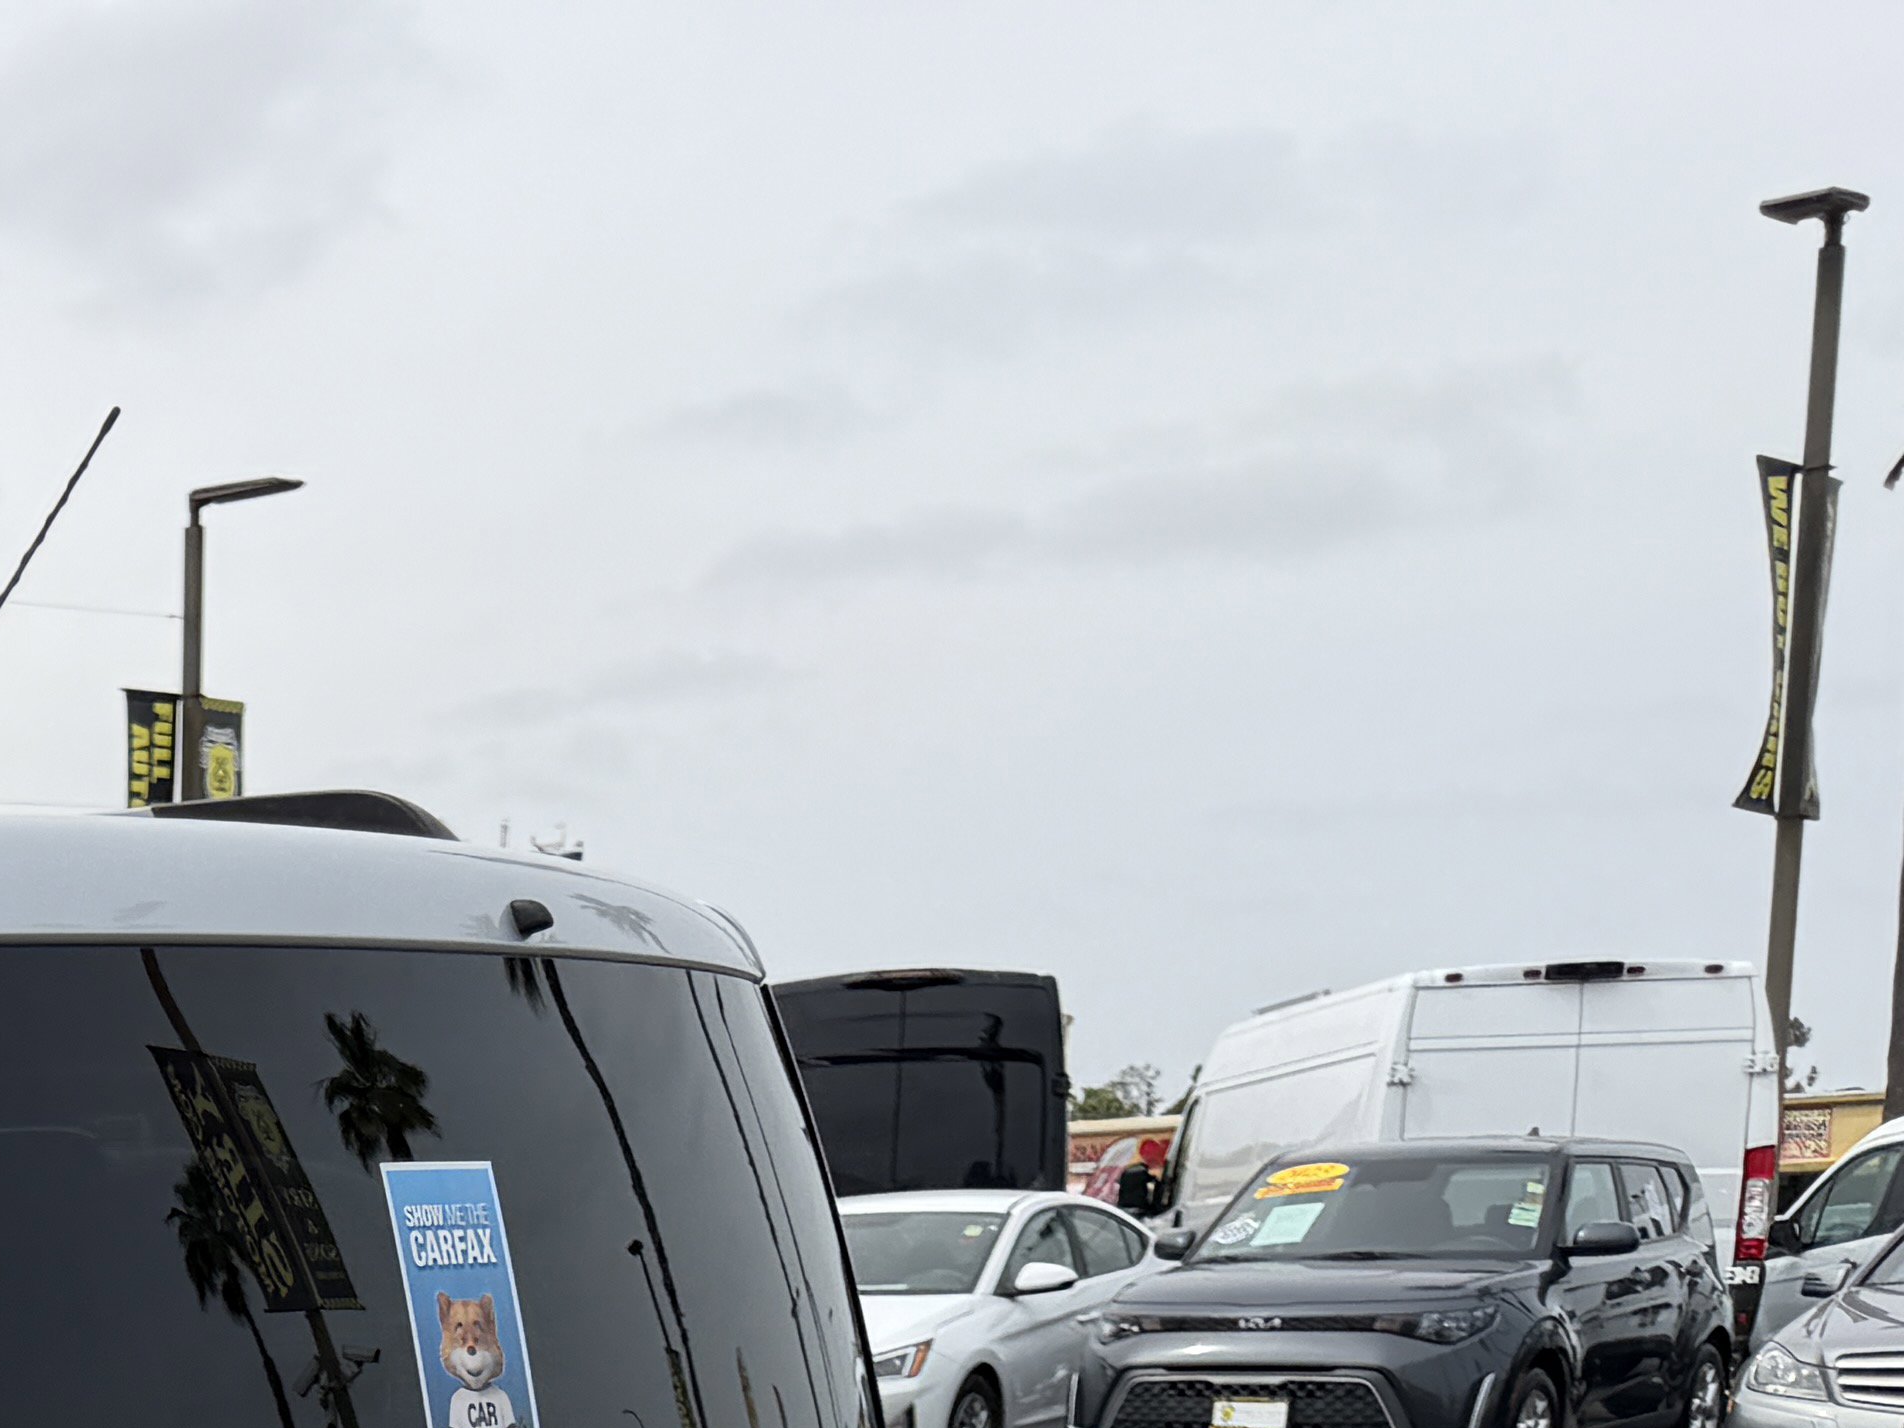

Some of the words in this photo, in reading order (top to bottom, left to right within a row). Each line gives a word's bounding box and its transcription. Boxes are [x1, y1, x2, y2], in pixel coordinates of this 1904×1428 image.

[403, 1203, 443, 1227] SHOW
[444, 1203, 466, 1226] ME
[467, 1202, 491, 1225] THE
[409, 1227, 498, 1268] CARFAX
[467, 1402, 498, 1428] CAR
